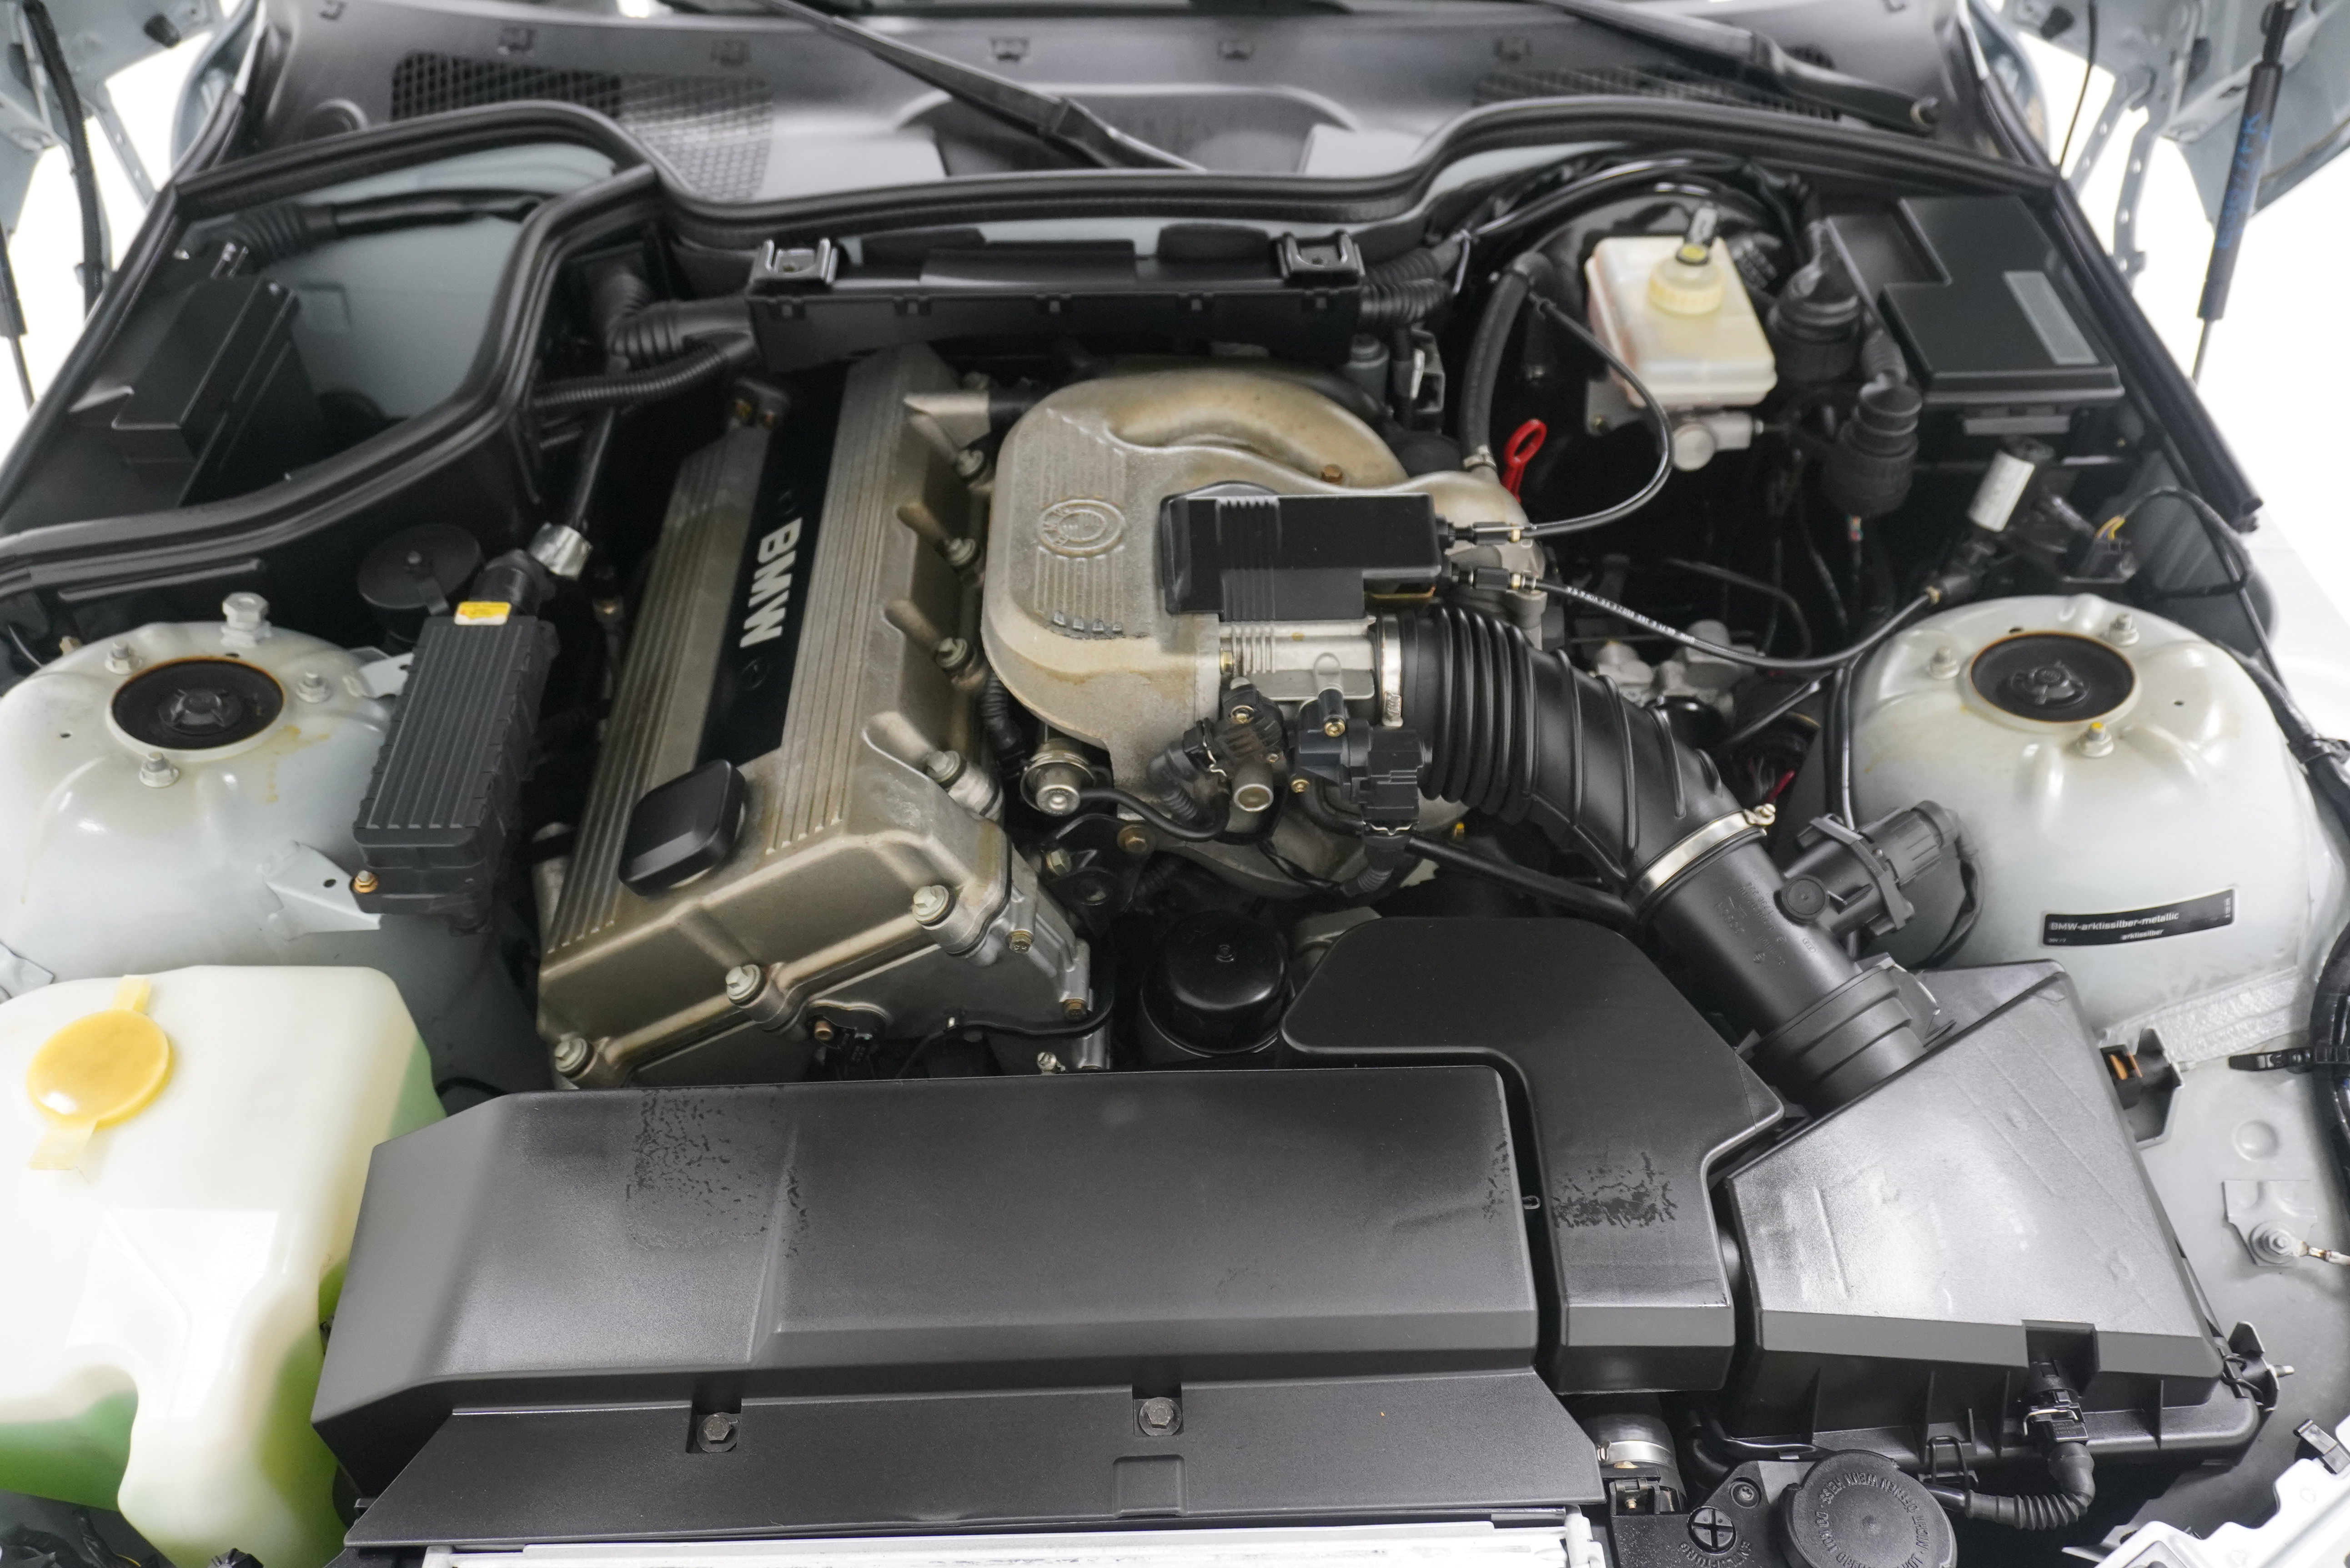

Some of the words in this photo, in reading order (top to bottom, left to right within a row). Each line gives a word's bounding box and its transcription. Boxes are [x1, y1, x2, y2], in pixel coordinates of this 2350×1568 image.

[739, 517, 803, 648] BMW
[2120, 928, 2164, 940] arktissilber
[1844, 1472, 1878, 1488] WENN
[1911, 1515, 1930, 1550] NICHT
